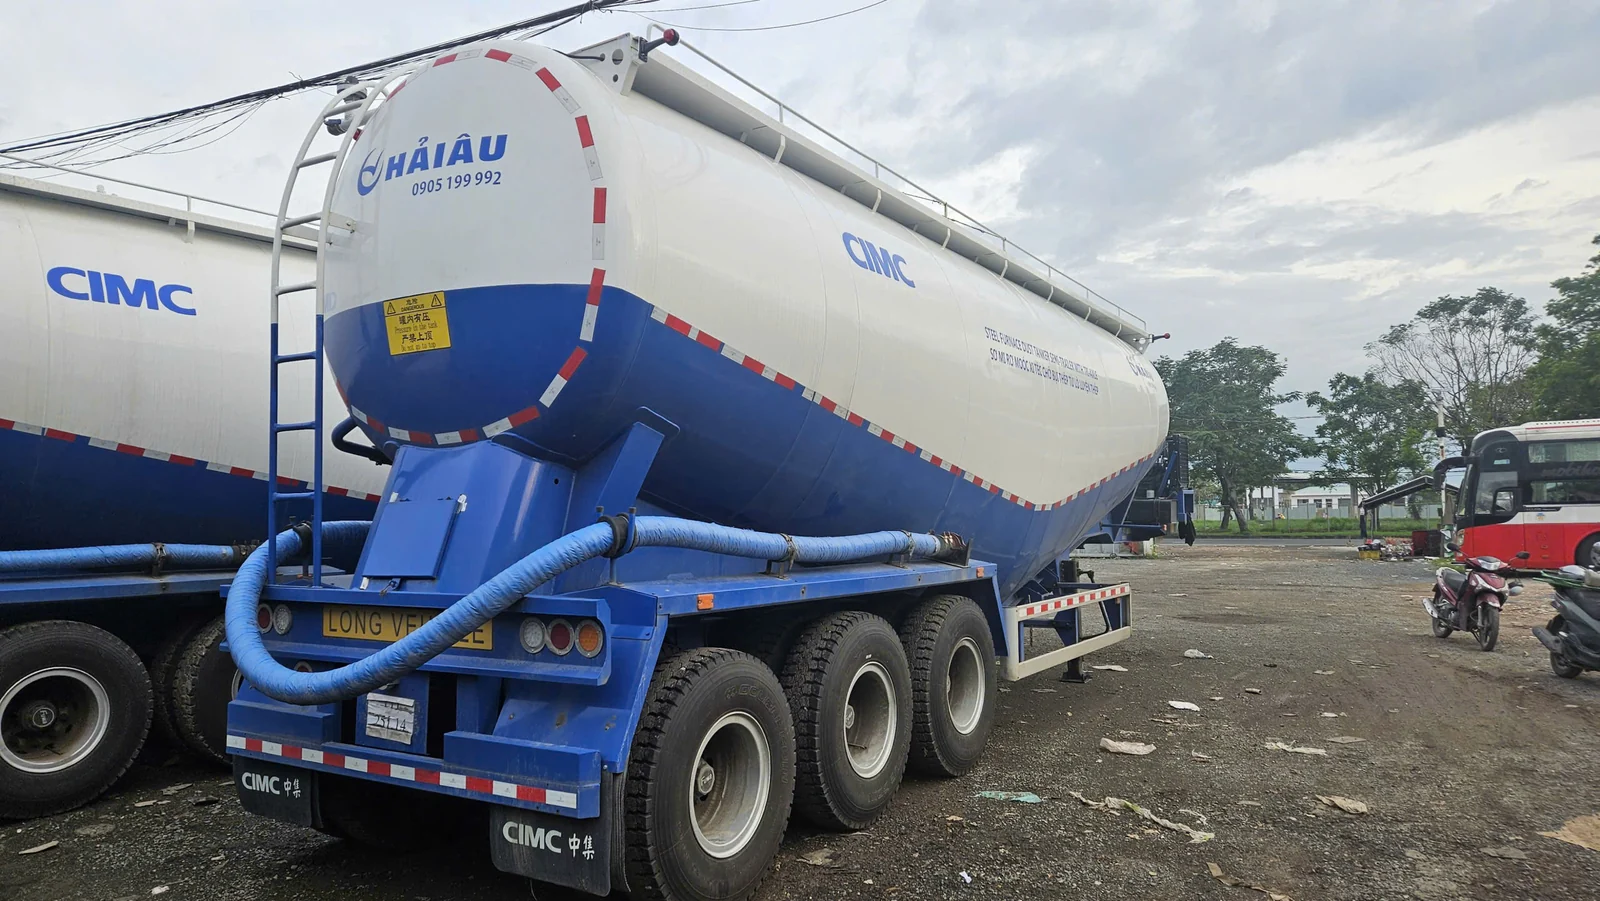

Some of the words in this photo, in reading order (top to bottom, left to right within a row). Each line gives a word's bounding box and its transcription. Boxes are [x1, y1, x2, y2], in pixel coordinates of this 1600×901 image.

[412, 178, 442, 196] 0905
[447, 174, 471, 190] 199
[475, 170, 501, 186] 992
[842, 232, 916, 288] CIMC
[46, 266, 197, 316] CIMC
[985, 326, 1000, 343] STEEL
[999, 332, 1022, 351] FURNACE
[328, 609, 382, 636] LONG
[241, 772, 281, 795] CIMC
[283, 777, 301, 799] 中集
[502, 821, 562, 854] CIMC
[568, 833, 595, 861] 中集
